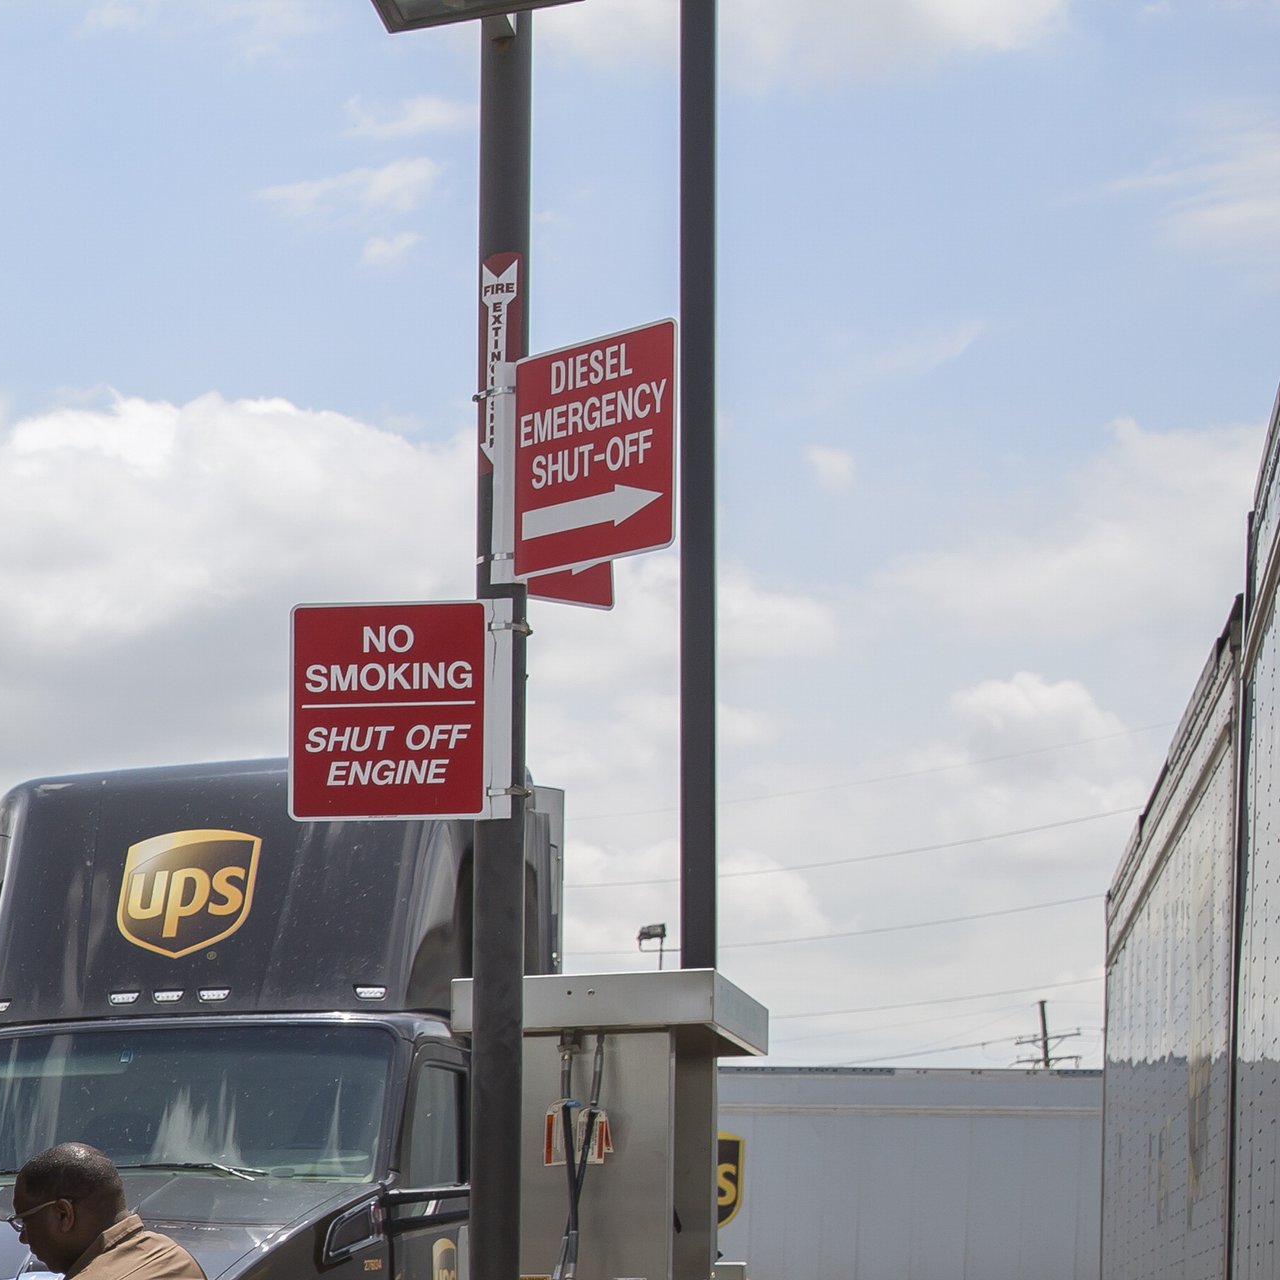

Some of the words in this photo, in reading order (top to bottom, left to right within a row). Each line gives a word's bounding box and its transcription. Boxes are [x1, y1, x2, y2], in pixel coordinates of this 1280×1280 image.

[483, 282, 515, 297] FIRE
[551, 343, 633, 395] DIESEL
[520, 378, 667, 449] EMERGENCY
[531, 428, 653, 489] SHUT-OFF
[363, 624, 415, 653] NO
[305, 660, 473, 693] SMOKING
[304, 725, 395, 752] SHUT
[405, 724, 472, 751] OFF
[326, 758, 450, 786] ENGINE
[127, 866, 246, 938] ups
